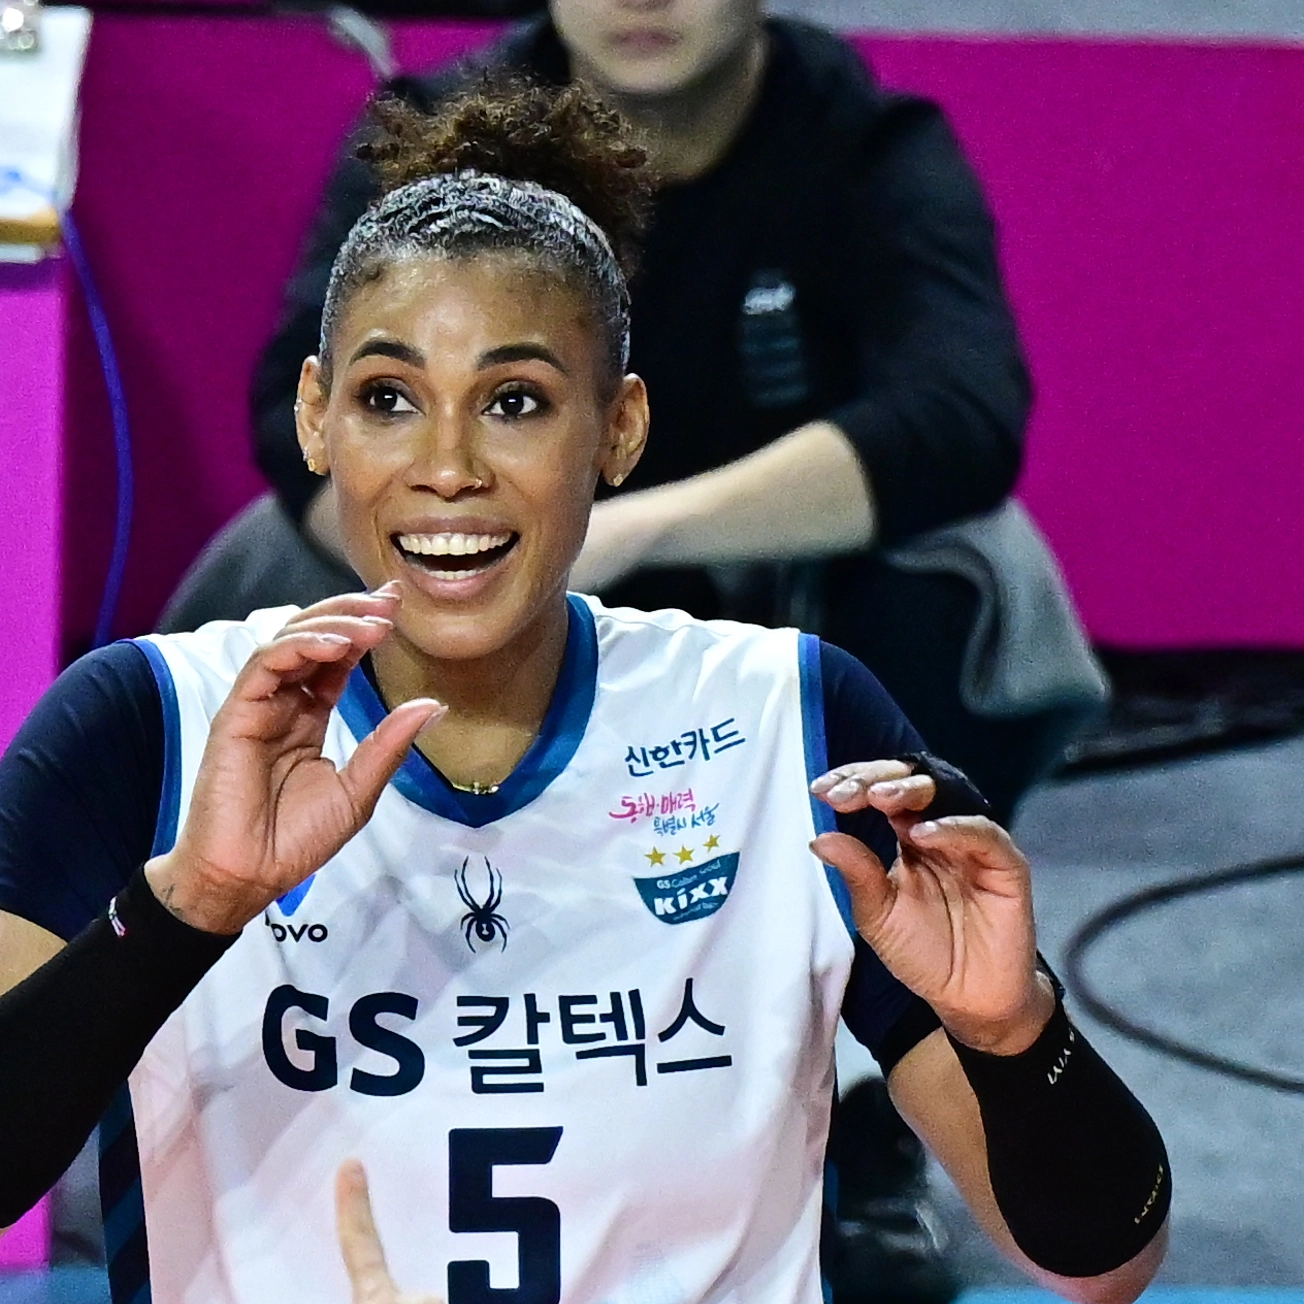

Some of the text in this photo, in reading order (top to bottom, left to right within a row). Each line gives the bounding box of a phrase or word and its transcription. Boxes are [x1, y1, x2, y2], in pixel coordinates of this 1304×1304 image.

[625, 717, 746, 777] 신한카드
[264, 907, 329, 943] OVO
[262, 977, 733, 1097] GS 칼텍스
